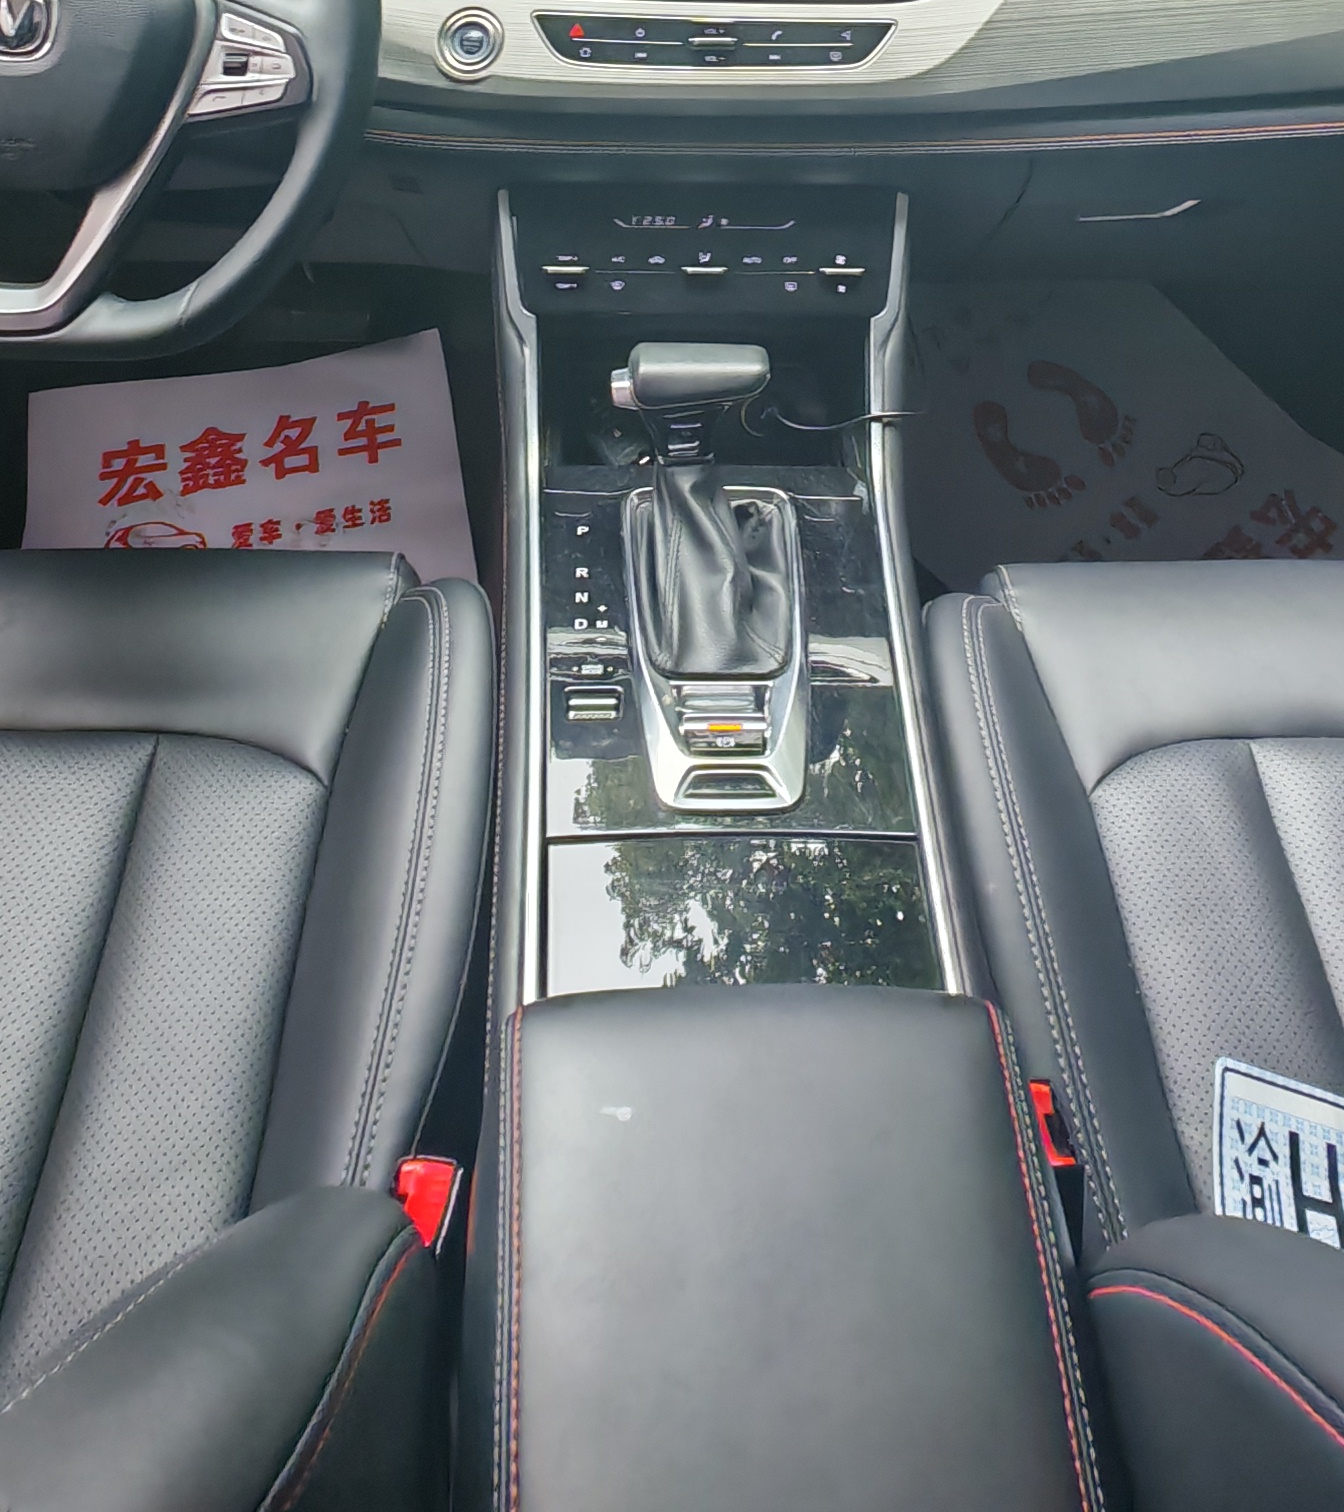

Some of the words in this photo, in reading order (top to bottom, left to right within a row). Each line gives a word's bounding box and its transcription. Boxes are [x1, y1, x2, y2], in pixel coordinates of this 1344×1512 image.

[97, 399, 403, 508] 宏鑫名车
[576, 525, 590, 536] P
[575, 567, 590, 579] R
[574, 592, 589, 603] N
[574, 618, 589, 630] D
